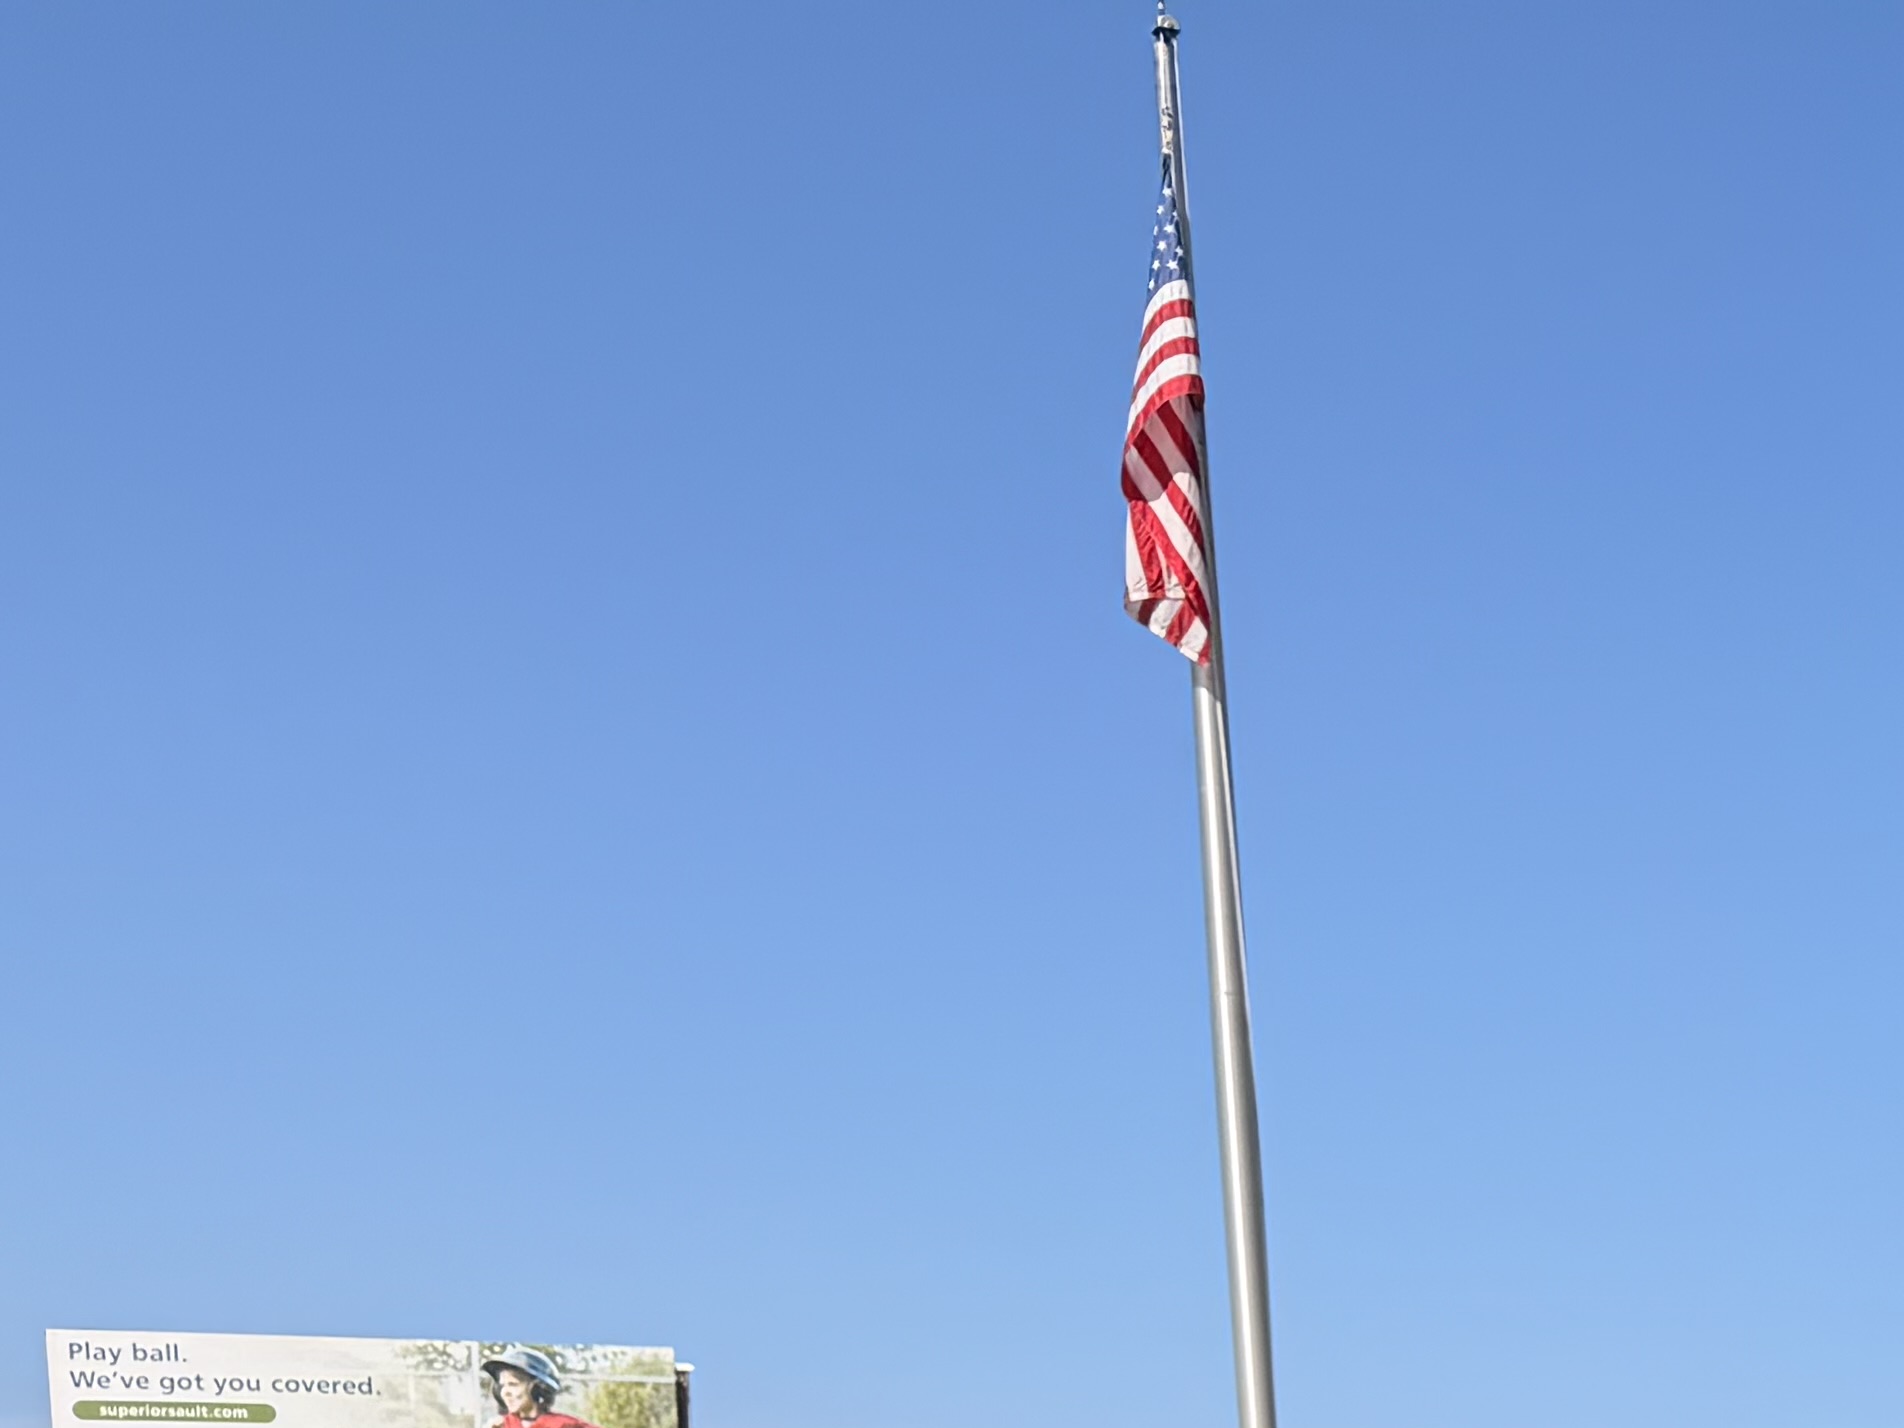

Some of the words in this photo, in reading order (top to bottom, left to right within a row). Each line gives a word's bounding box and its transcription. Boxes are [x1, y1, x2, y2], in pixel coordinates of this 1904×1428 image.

[68, 1341, 122, 1366] Play
[132, 1342, 188, 1363] ball.
[70, 1370, 150, 1389] We've
[159, 1373, 205, 1395] got
[213, 1377, 261, 1396] you
[271, 1376, 381, 1396] covered.
[99, 1404, 249, 1419] superiorsault.com
